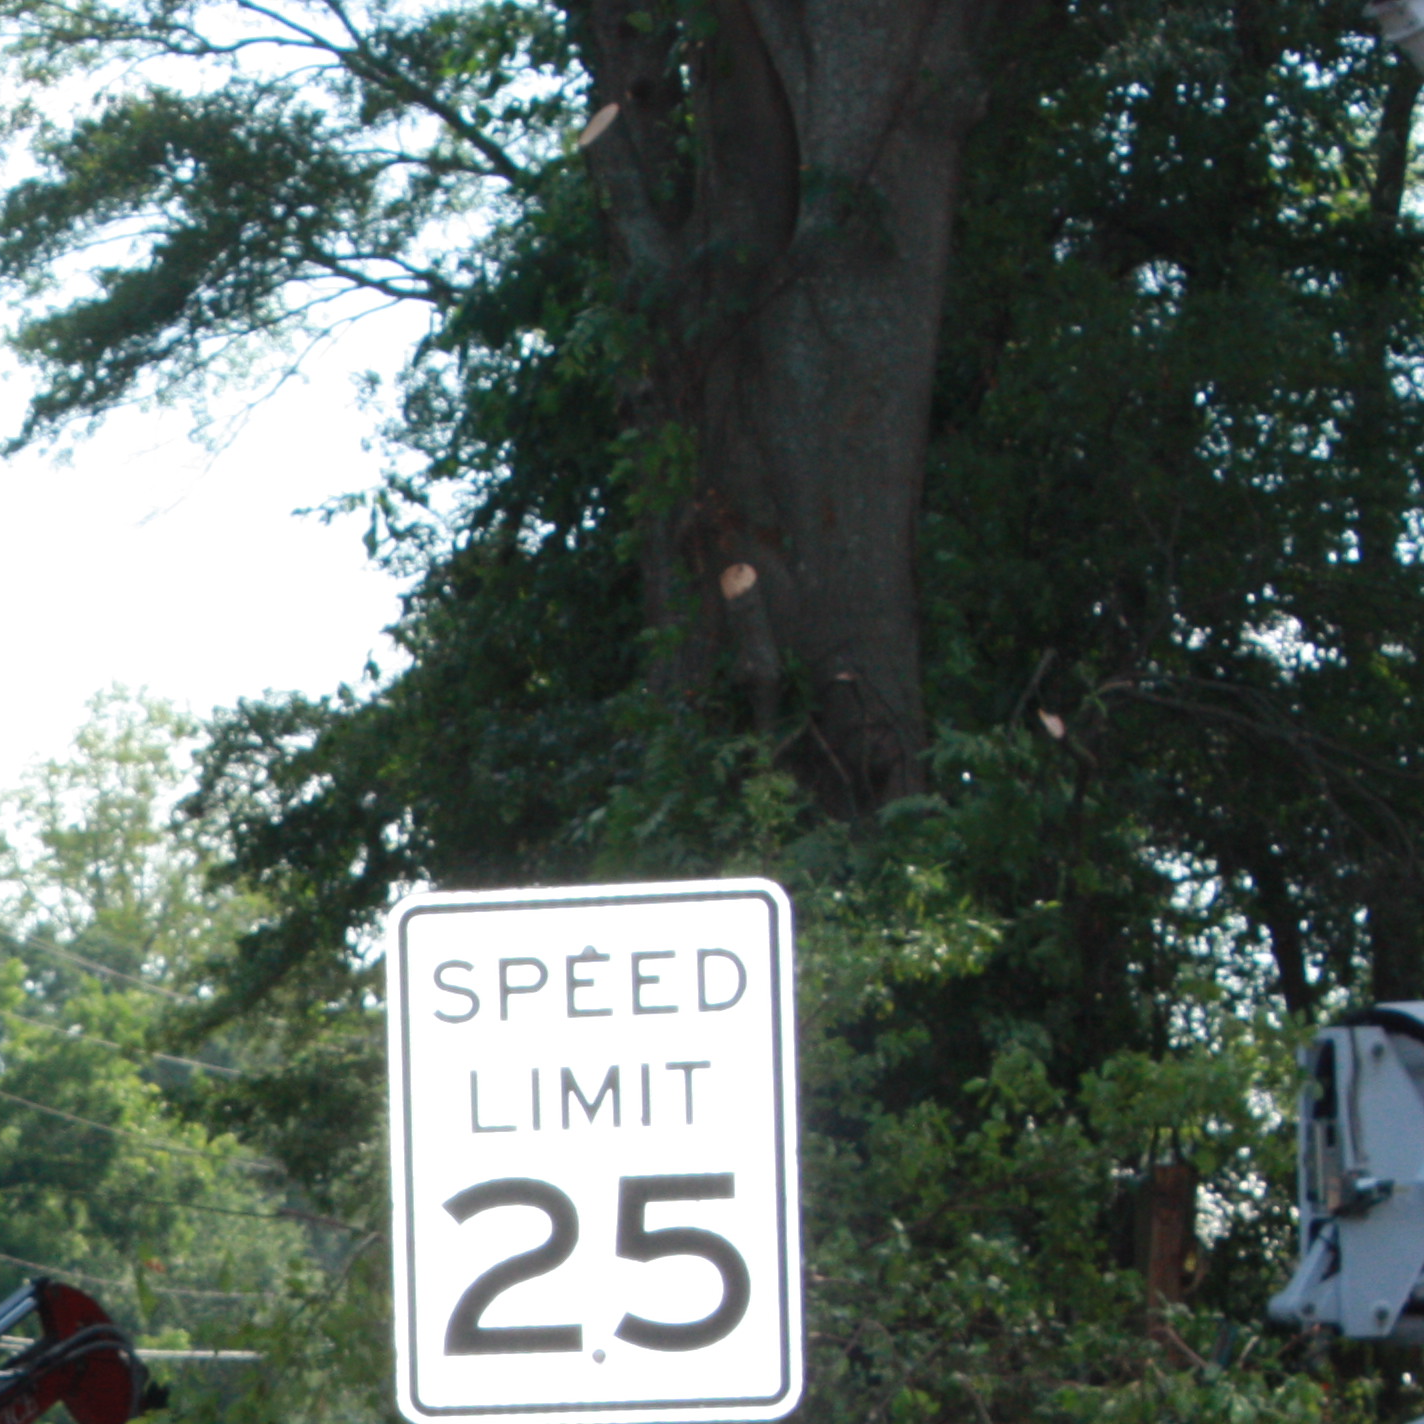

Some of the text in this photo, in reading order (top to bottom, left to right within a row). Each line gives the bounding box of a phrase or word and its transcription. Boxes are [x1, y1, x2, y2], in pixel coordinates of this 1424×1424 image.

[433, 946, 747, 1024] SPEED
[470, 1060, 711, 1133] LIMIT
[442, 1172, 751, 1357] 25
